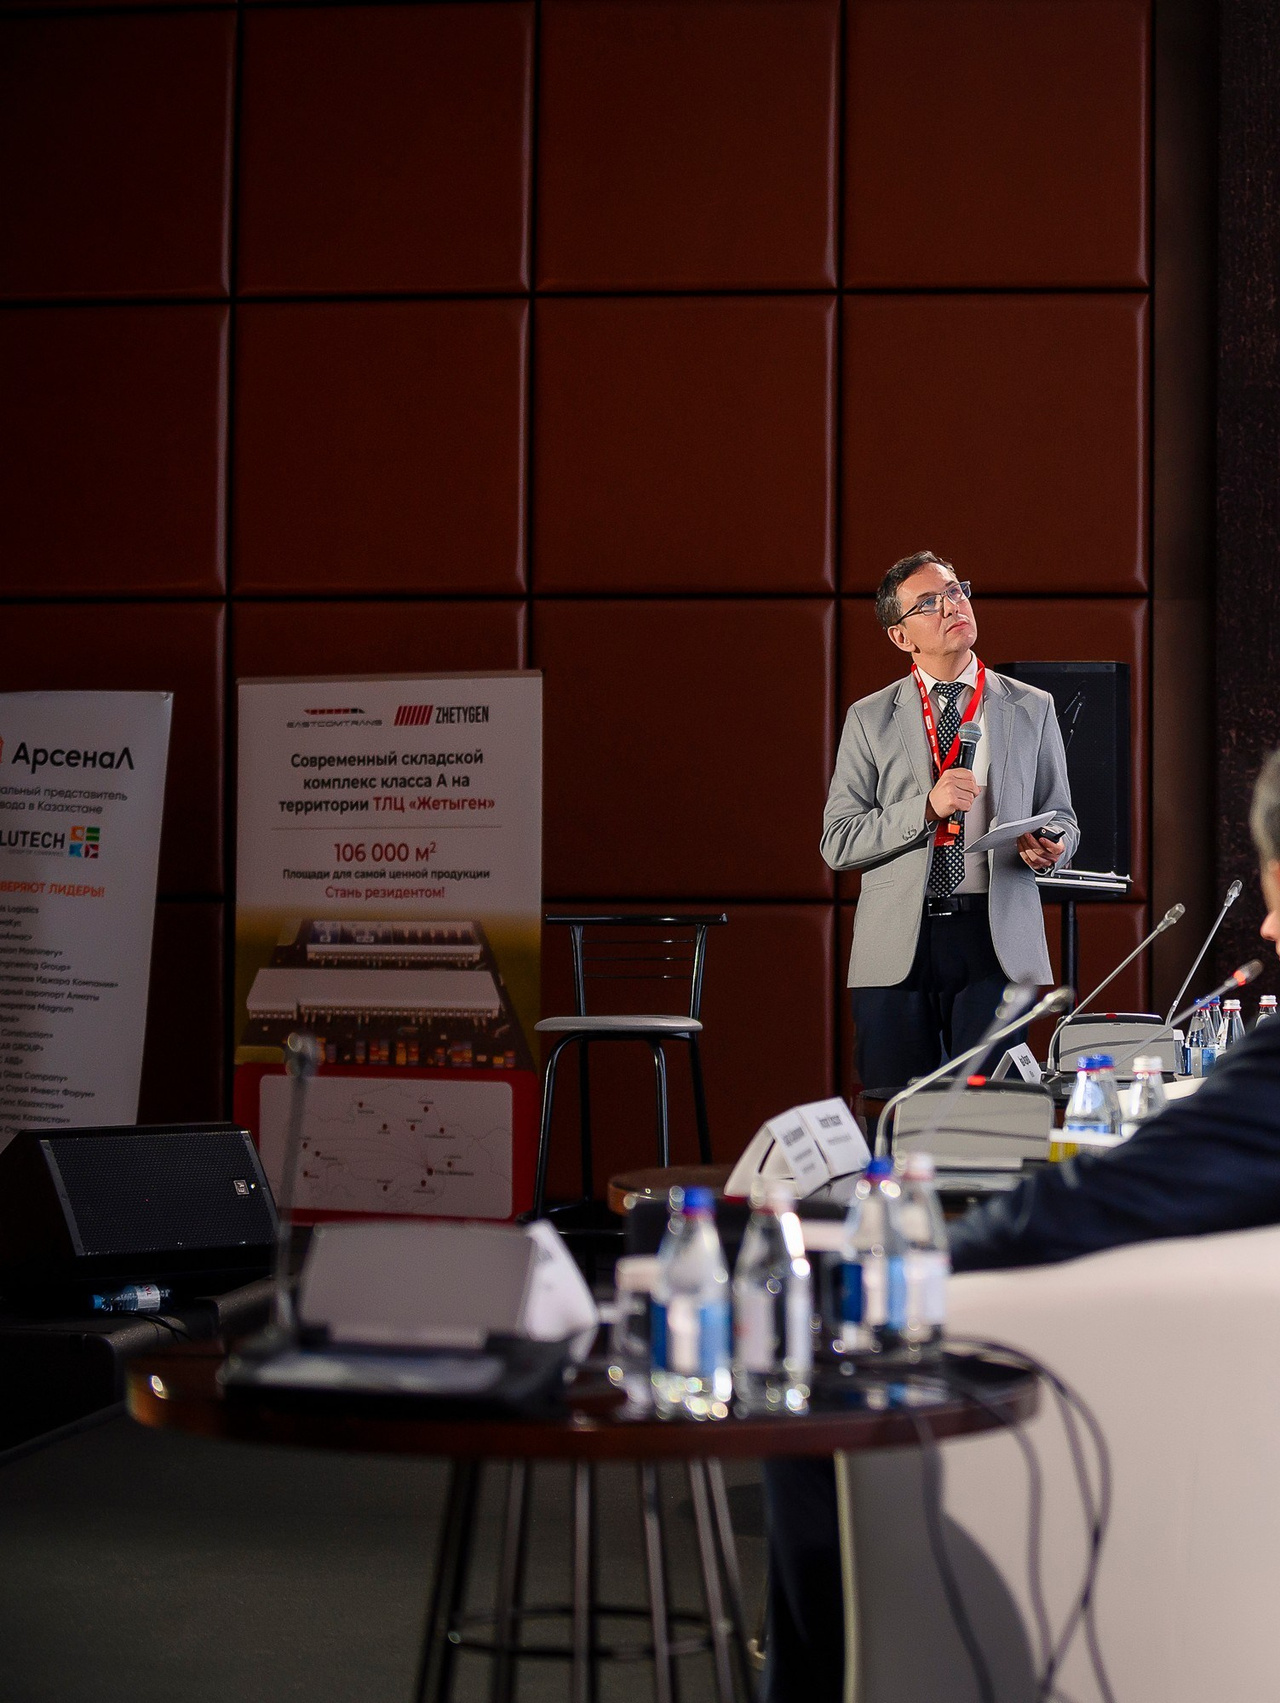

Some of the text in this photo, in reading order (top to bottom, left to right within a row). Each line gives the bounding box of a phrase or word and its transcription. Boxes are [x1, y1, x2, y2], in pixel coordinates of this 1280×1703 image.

[435, 706, 490, 724] ZHETYGEN
[286, 719, 383, 728] EASTCOMTRANS
[290, 749, 484, 770] Современный складской
[303, 776, 377, 790] комплекс
[380, 776, 432, 789] класса
[451, 775, 470, 788] на
[43, 788, 128, 802] представитель
[28, 802, 35, 811] в
[37, 800, 104, 815] Казахстане
[278, 795, 496, 815] территории ТЛЦ «Жетыген»
[334, 843, 366, 863] 106
[371, 843, 410, 862] 000
[282, 868, 490, 881] Площади для самой ценной продукции
[49, 882, 105, 898] ЛИДЕРЫ!
[325, 886, 445, 900] Стань резидентом!
